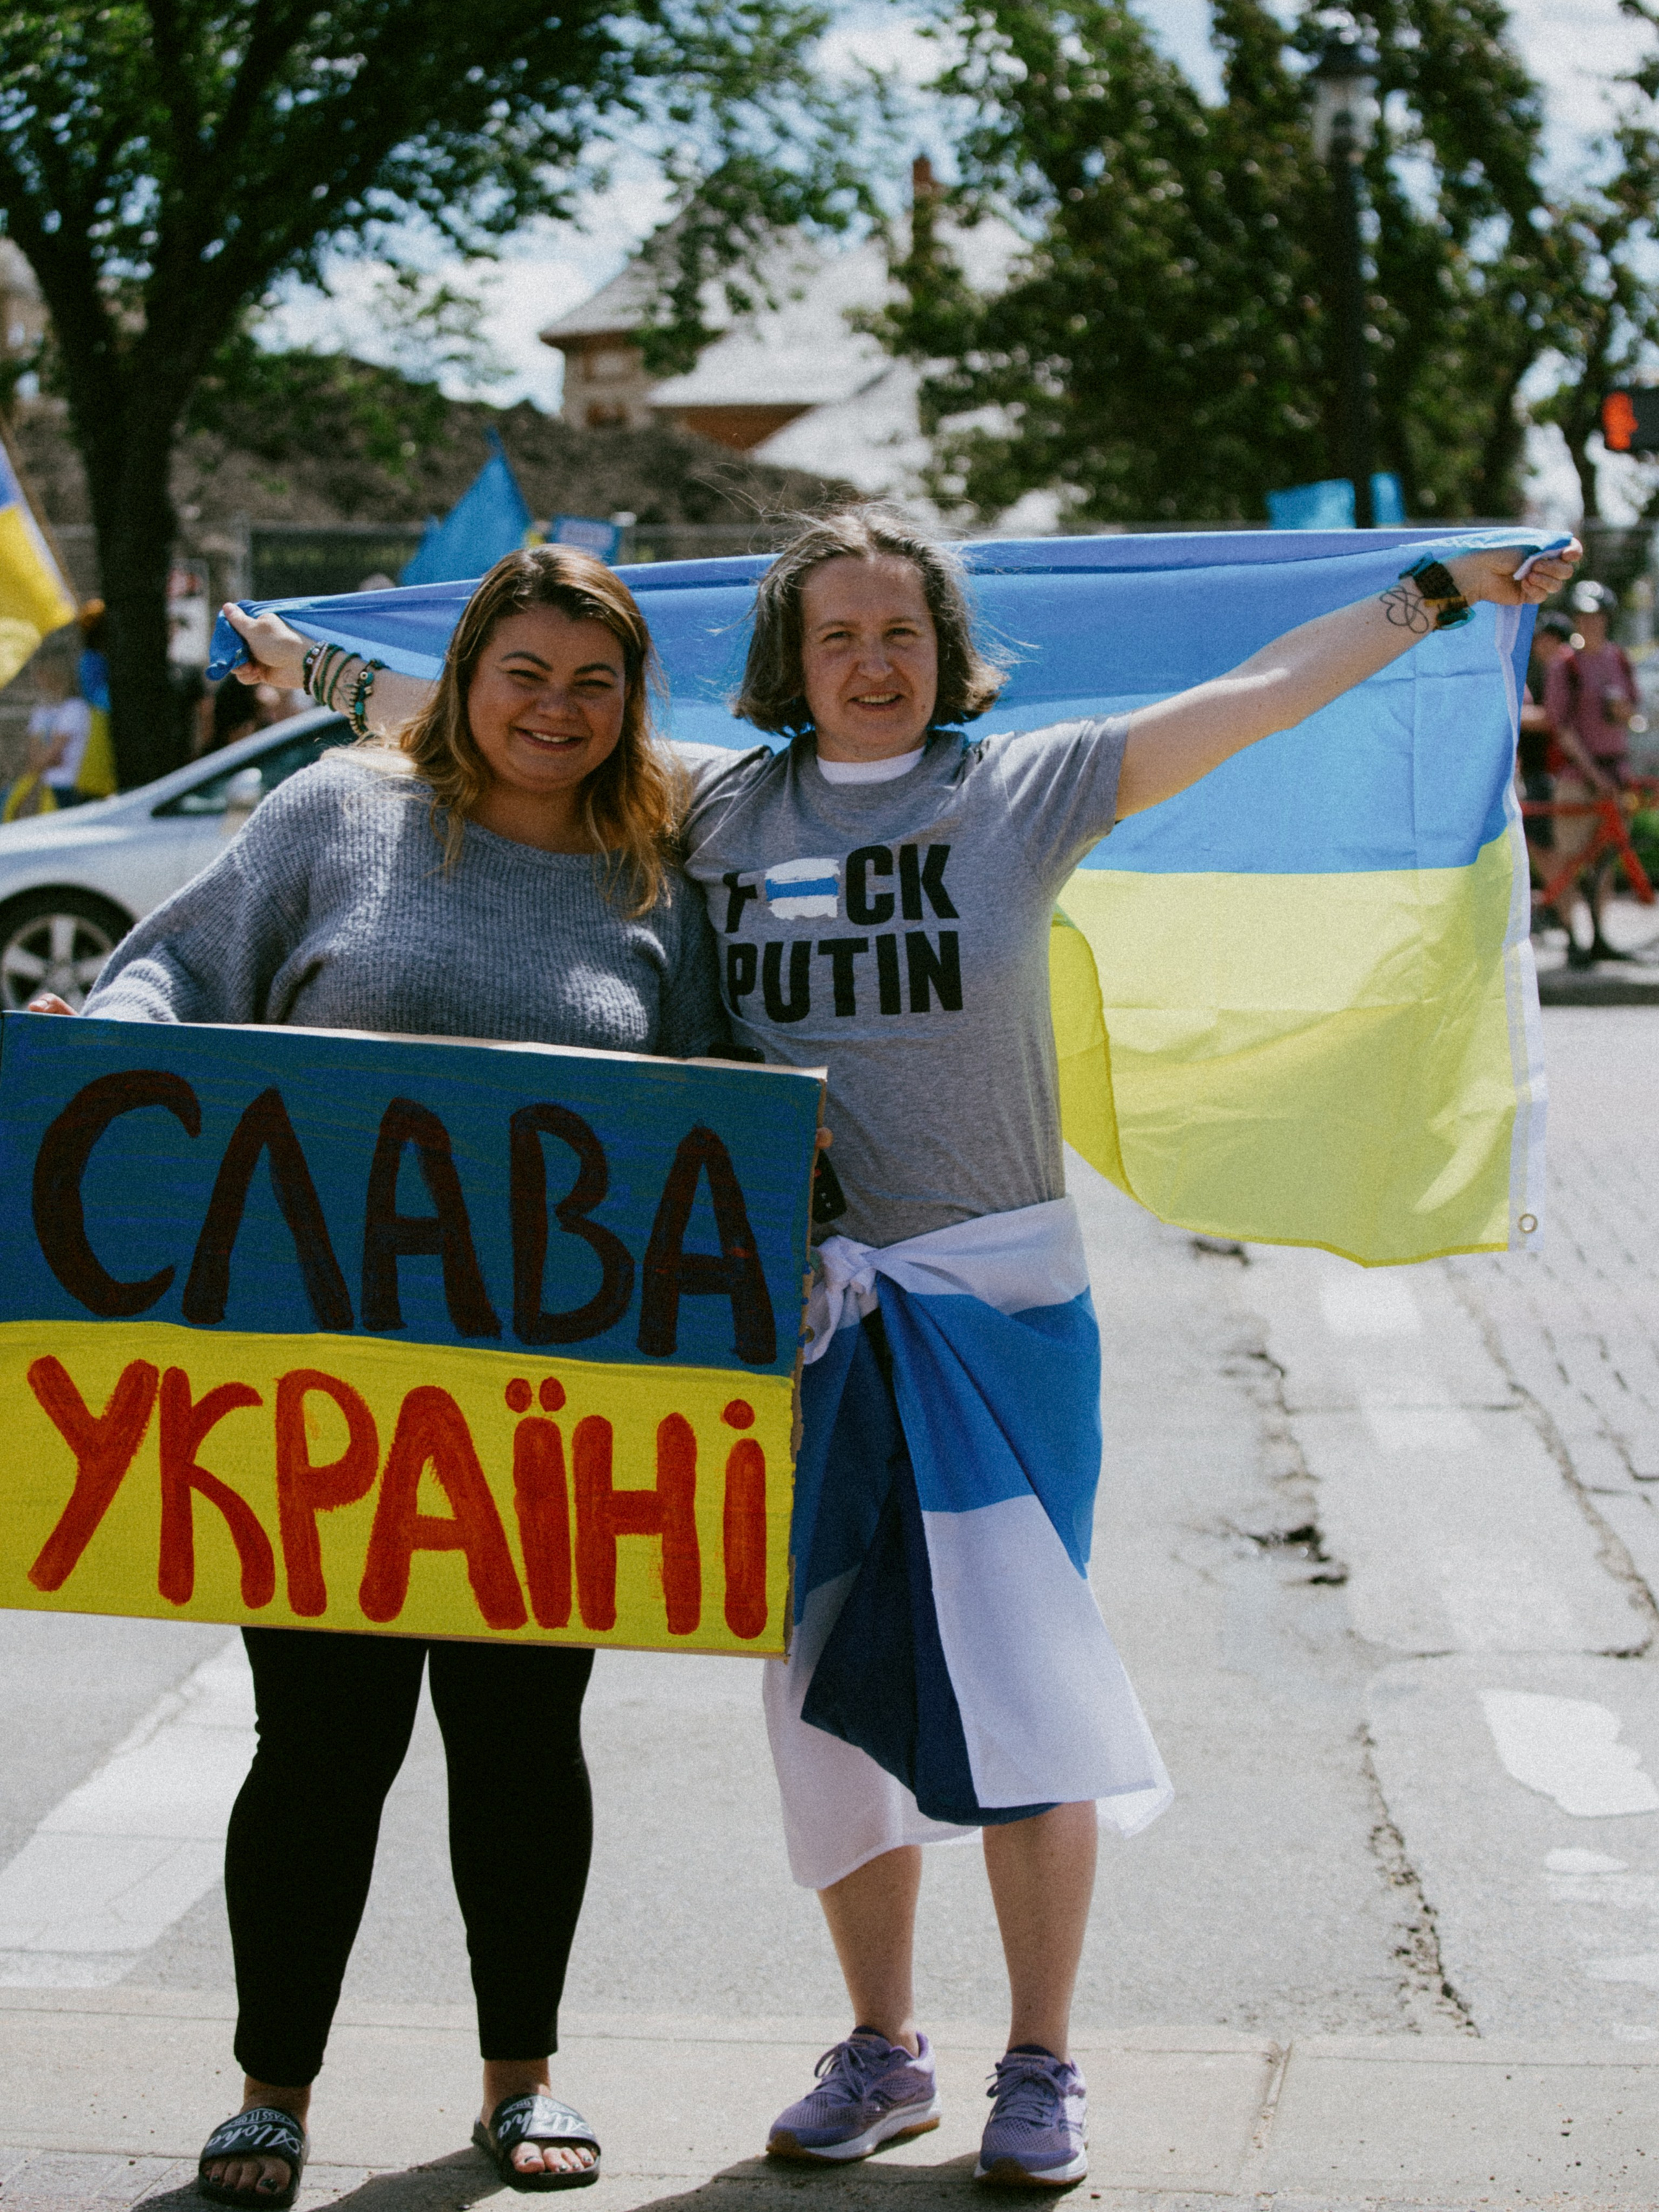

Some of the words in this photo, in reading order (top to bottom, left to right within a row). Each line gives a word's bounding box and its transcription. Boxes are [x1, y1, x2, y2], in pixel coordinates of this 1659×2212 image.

[723, 843, 960, 933] FCK
[726, 930, 964, 1024] PUTIN
[32, 1069, 777, 1366] СЛАВА
[27, 1355, 769, 1640] УКРАЇНІ
[249, 2112, 259, 2121] IT
